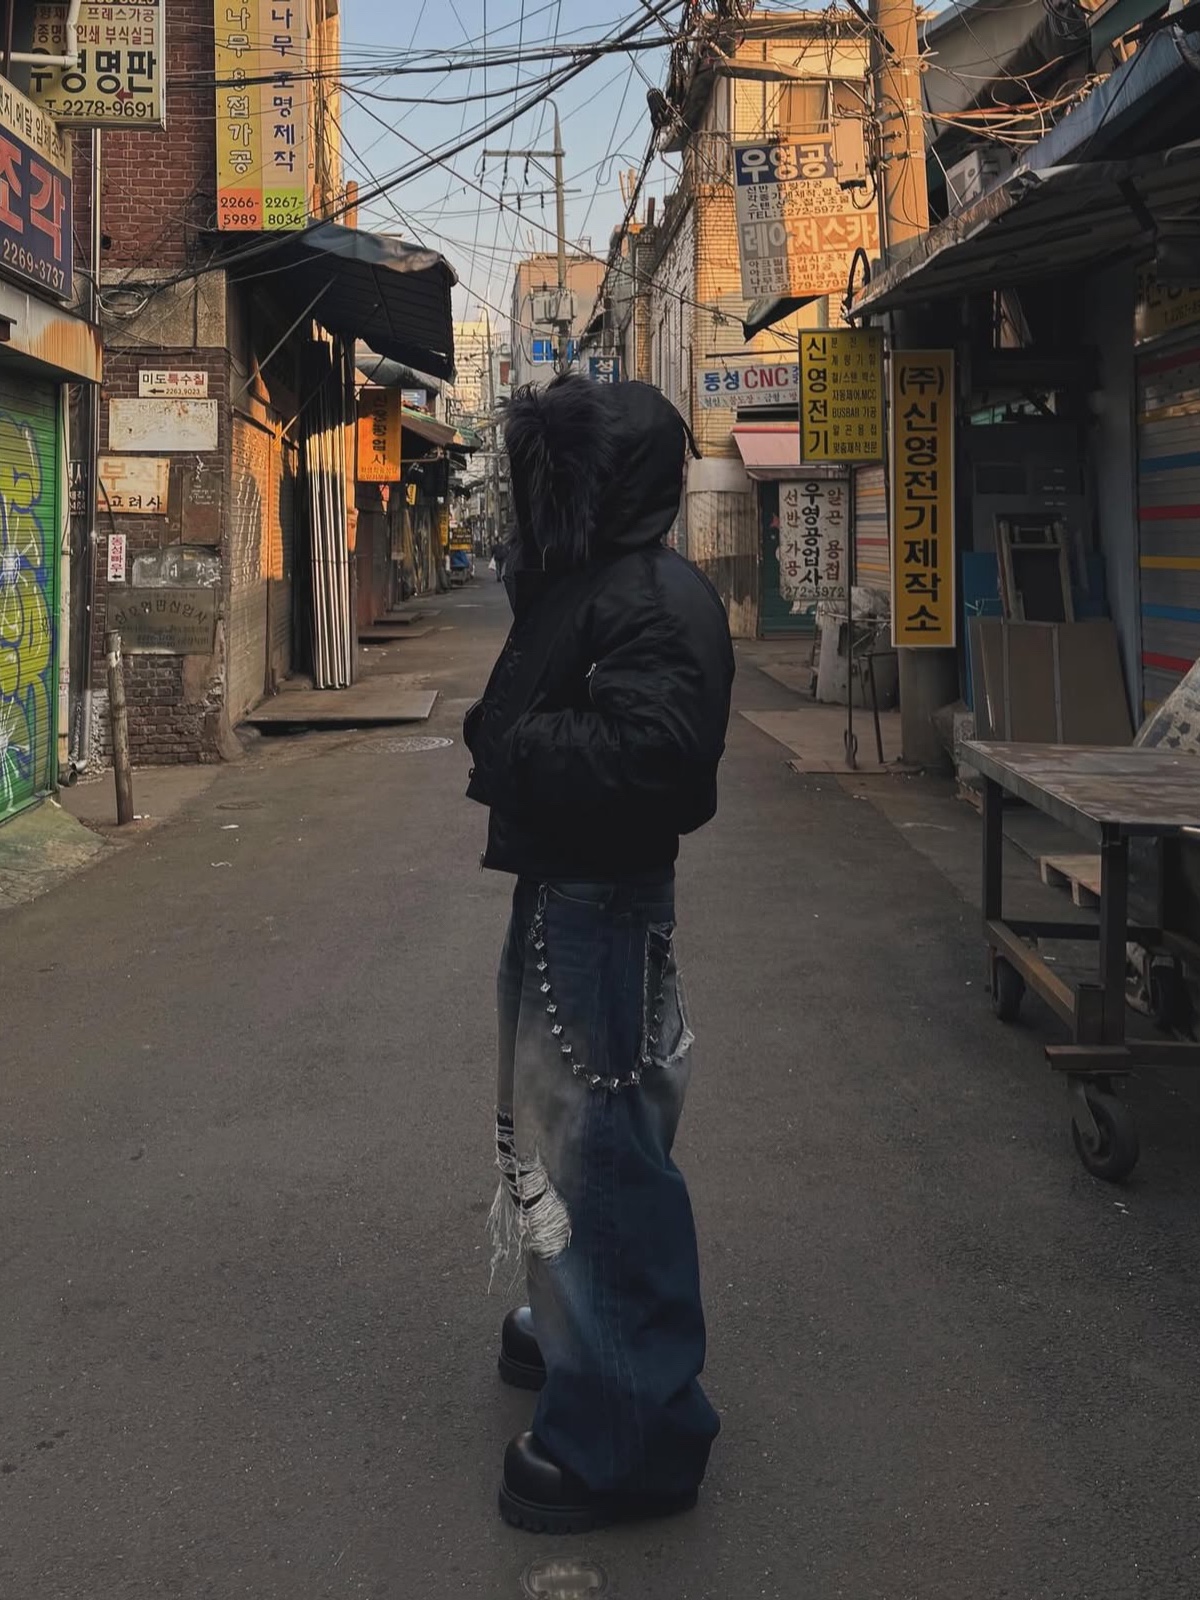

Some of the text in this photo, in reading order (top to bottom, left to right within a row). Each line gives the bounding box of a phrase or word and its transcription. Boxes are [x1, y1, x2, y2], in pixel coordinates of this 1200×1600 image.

[87, 7, 154, 23] 프레스가공
[105, 26, 155, 45] 부식실크
[741, 144, 837, 184] 우영공
[220, 196, 260, 208] 2266-
[265, 196, 304, 209] 2267-
[223, 213, 258, 226] 5989
[267, 213, 302, 226] 8036
[3, 237, 66, 290] 2269-3737
[704, 370, 740, 392] 동성
[744, 367, 789, 389] CNC
[806, 337, 829, 455] 신영전기
[799, 482, 825, 587] 우영공업사
